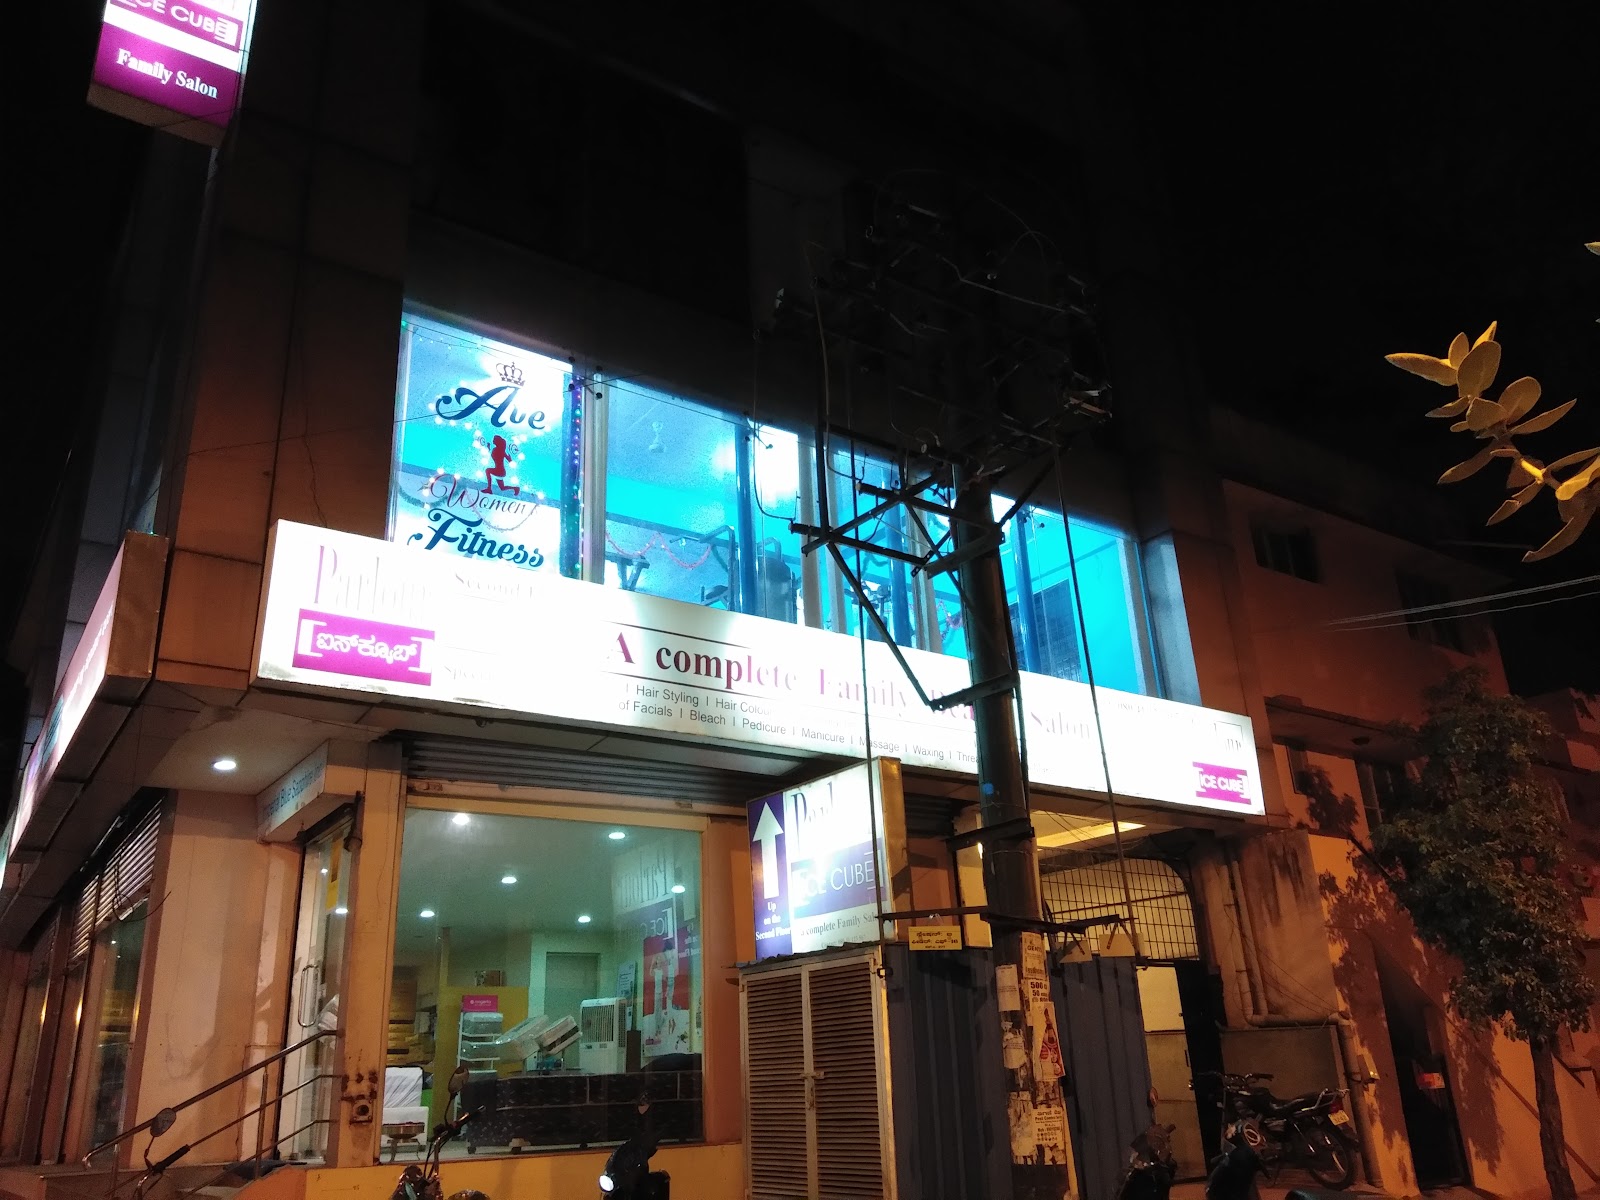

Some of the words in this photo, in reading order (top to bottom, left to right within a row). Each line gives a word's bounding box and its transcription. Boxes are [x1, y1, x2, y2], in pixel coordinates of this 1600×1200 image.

[170, 5, 226, 40] CUBE
[116, 48, 173, 85] Family
[175, 70, 218, 99] Salon
[435, 385, 546, 430] Ave
[407, 507, 545, 568] Fitness
[655, 646, 797, 691] complete
[636, 684, 660, 699] Hair
[662, 688, 700, 708] Styling
[715, 697, 737, 711] Hair
[618, 701, 629, 712] of
[633, 701, 673, 718] Facials
[689, 709, 726, 726] Bleach
[742, 718, 787, 735] Pedicure
[801, 727, 845, 744] Manicure
[859, 736, 900, 753] Massage
[912, 745, 945, 760] Waxing
[1217, 776, 1244, 793] CUBE
[830, 862, 875, 891] CUBE
[767, 901, 777, 913] Up
[837, 915, 861, 928] Family
[755, 927, 776, 941] Second
